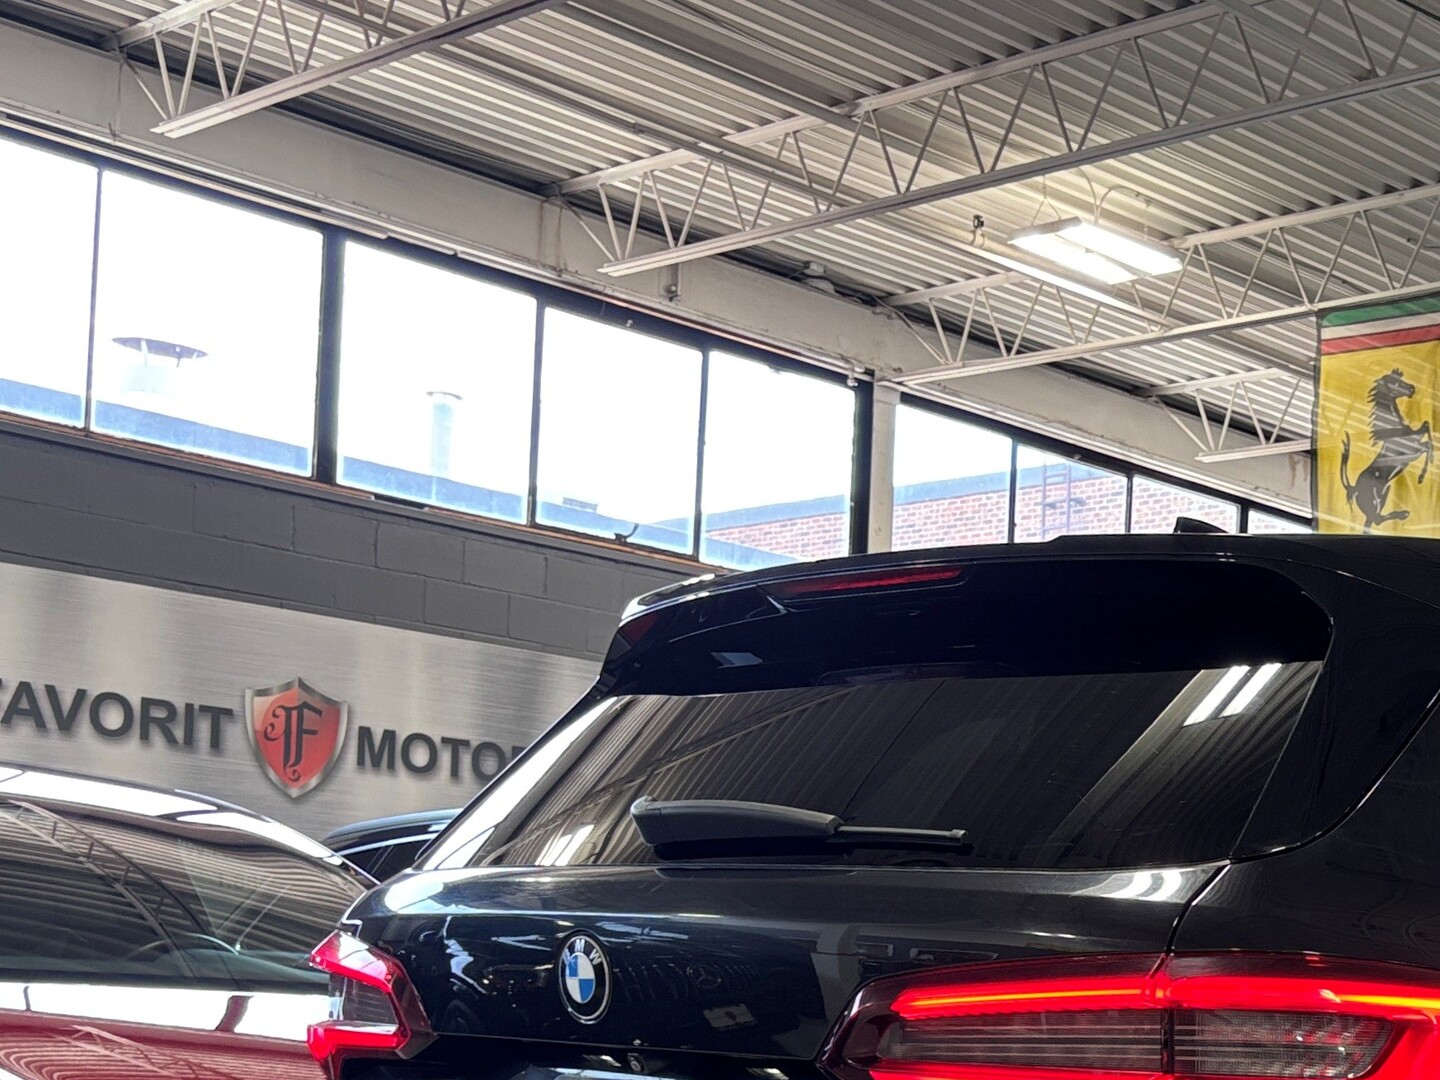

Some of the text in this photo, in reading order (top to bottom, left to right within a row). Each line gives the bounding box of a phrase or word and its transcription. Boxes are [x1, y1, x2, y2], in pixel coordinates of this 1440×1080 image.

[0, 677, 233, 748] AVORIT
[357, 726, 528, 785] MOTO
[561, 938, 602, 966] BMW
